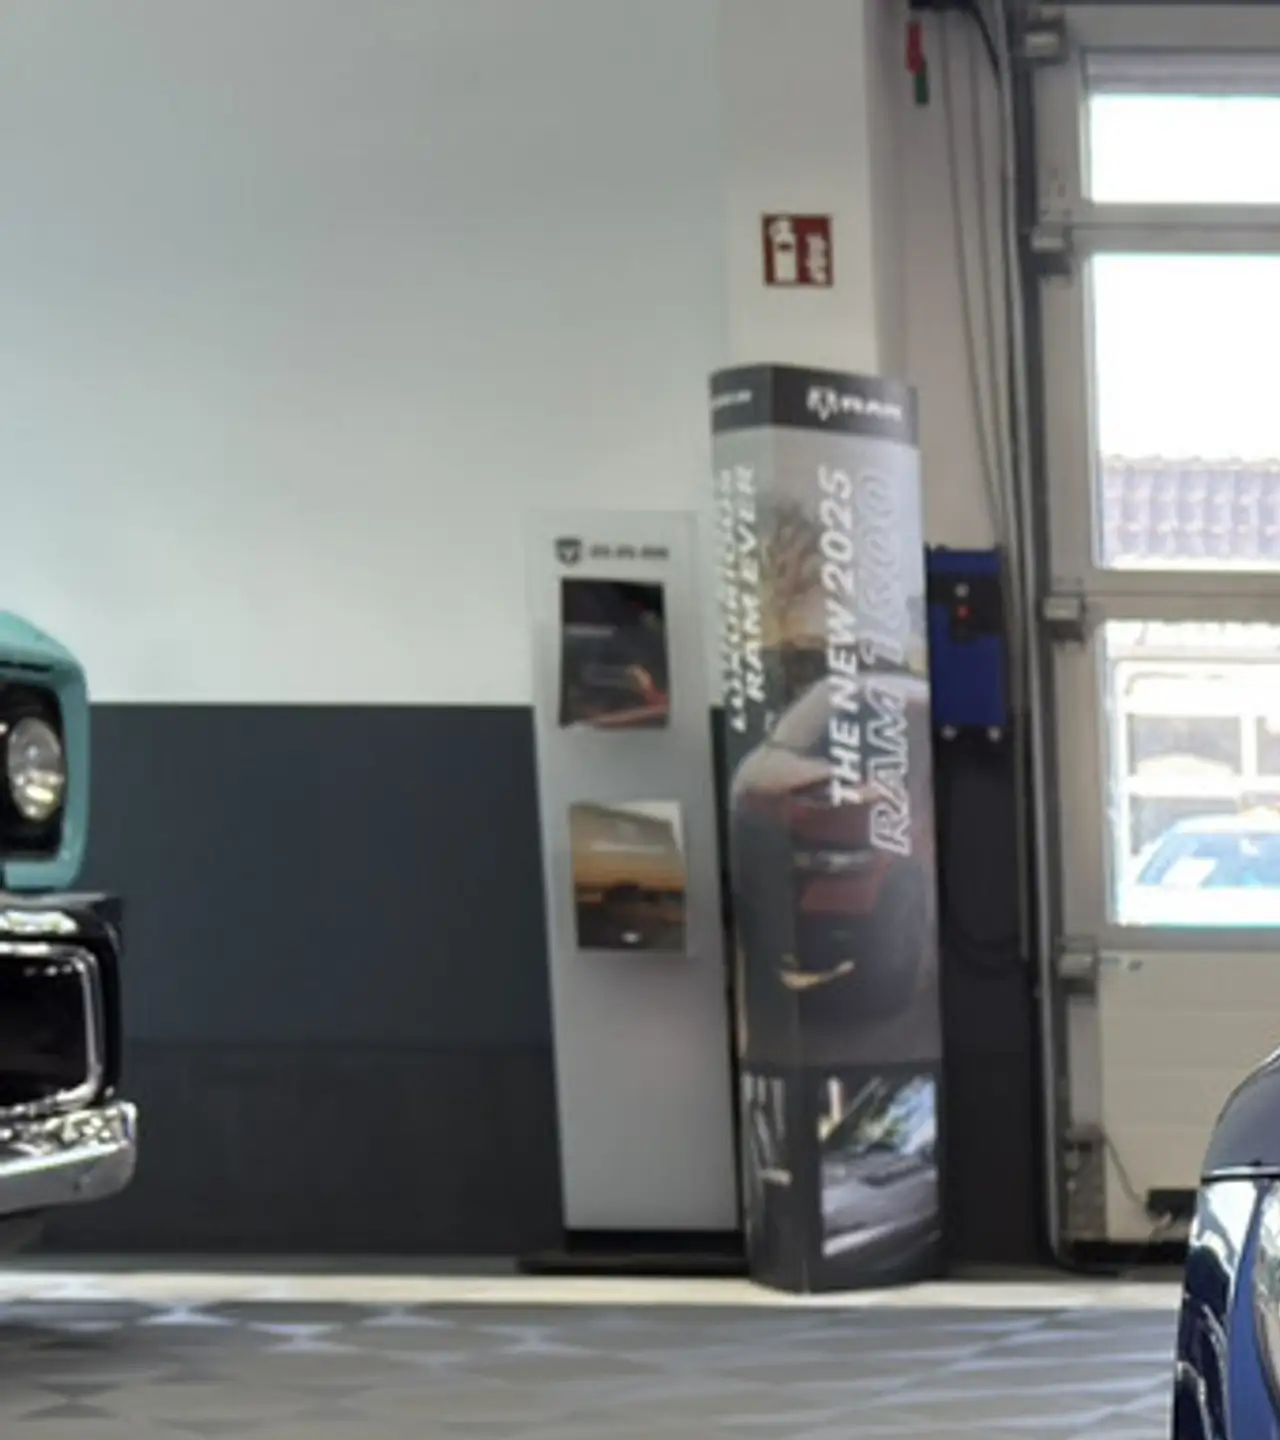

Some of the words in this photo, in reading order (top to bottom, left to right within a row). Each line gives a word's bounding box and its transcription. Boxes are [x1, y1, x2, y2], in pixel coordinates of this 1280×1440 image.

[734, 464, 760, 584] EVER
[817, 464, 854, 598] 2025
[741, 594, 766, 703] RAM
[825, 600, 862, 713] NEW
[827, 717, 864, 807] THE
[864, 682, 912, 856] RAM
